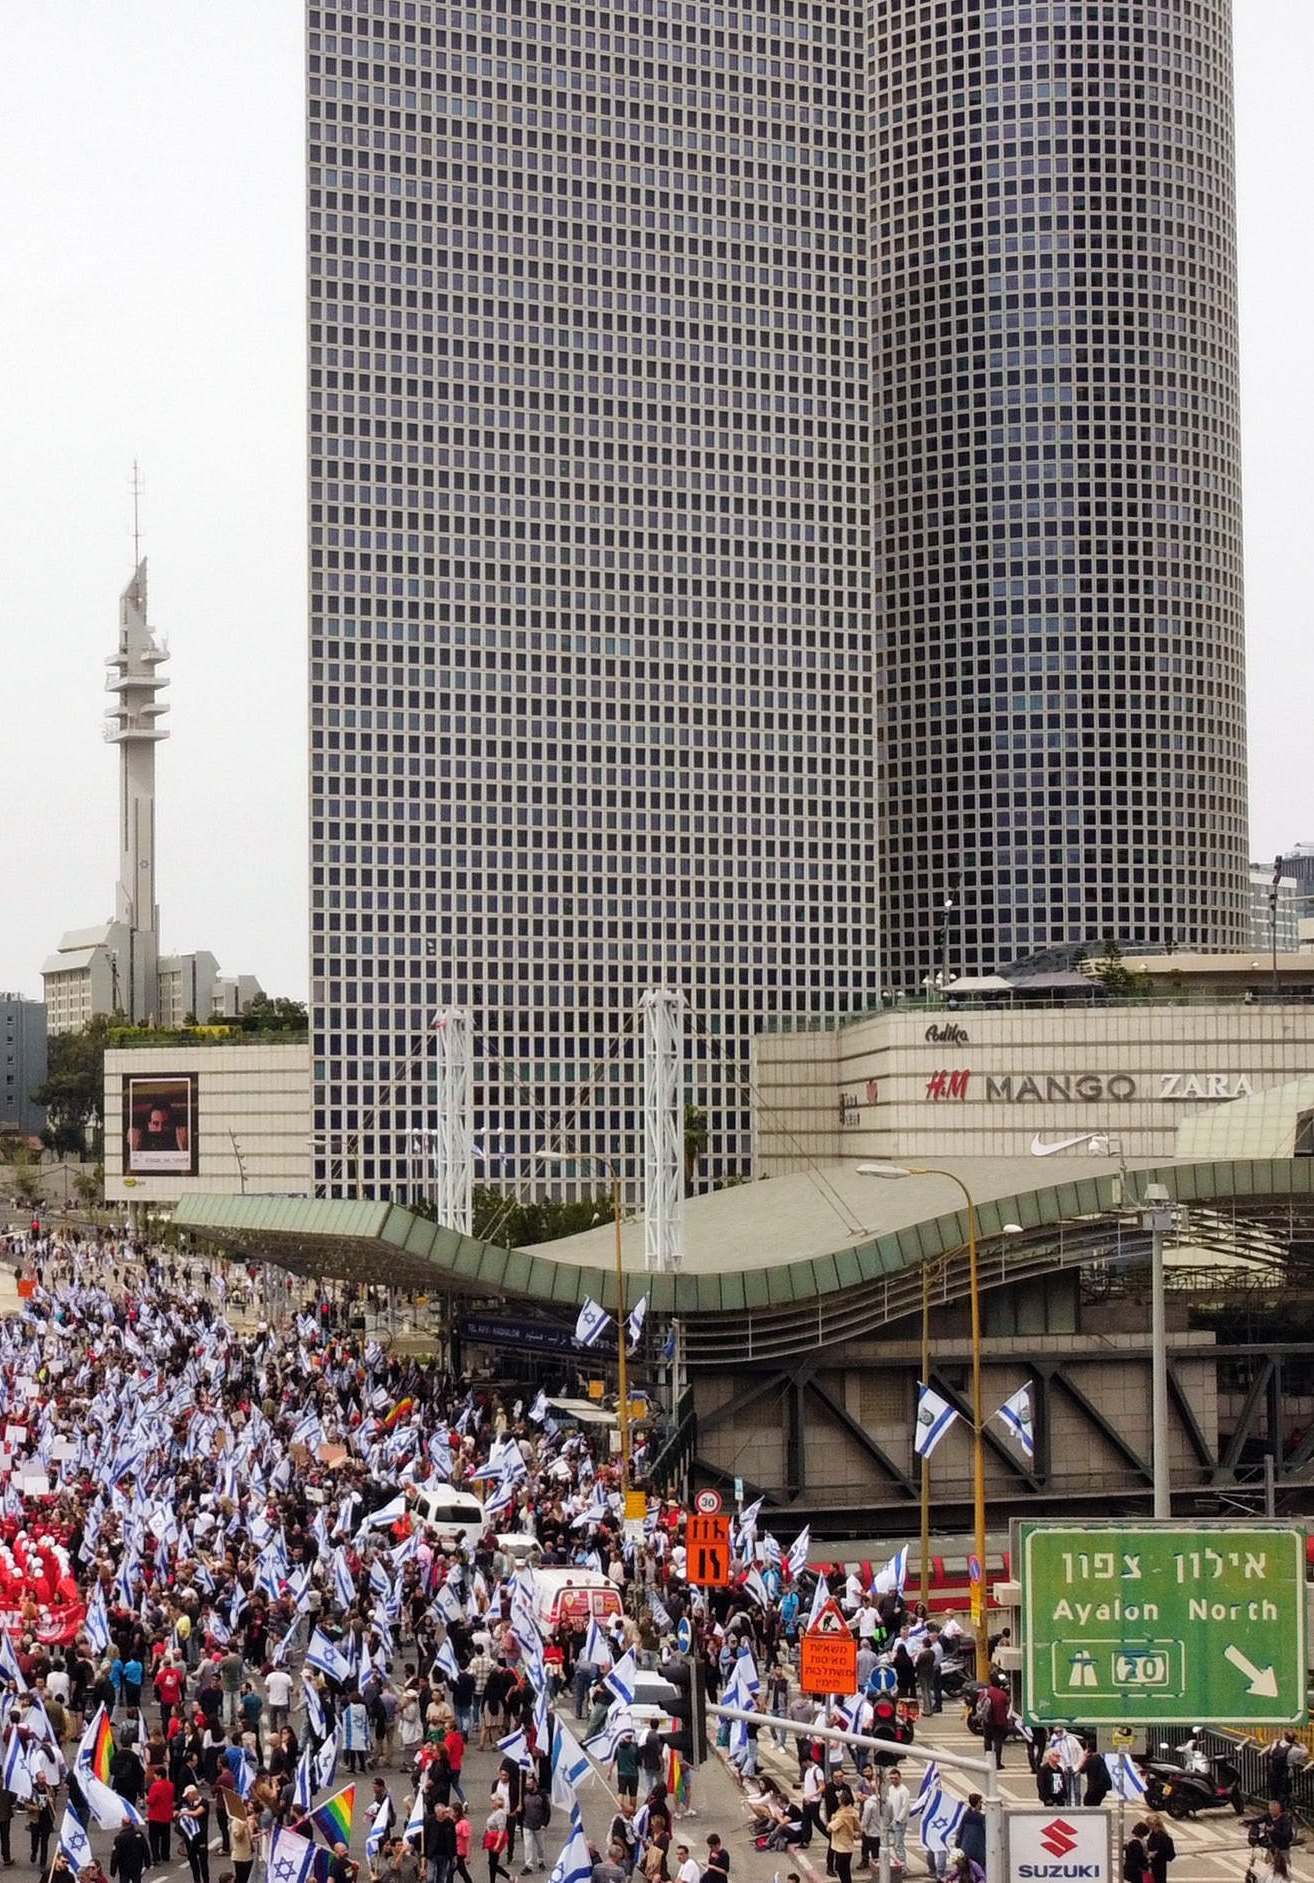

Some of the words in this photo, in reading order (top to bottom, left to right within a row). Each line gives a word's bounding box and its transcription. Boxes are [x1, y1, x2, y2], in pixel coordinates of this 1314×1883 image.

[925, 1023, 969, 1047] Adika
[926, 1069, 970, 1100] H&M
[986, 1074, 1135, 1102] MANGO
[1160, 1074, 1253, 1099] ZARA
[701, 1497, 715, 1507] 30
[1062, 1552, 1141, 1583] צפון
[1174, 1547, 1266, 1583] אילון
[1053, 1598, 1159, 1625] Ayalon
[1189, 1599, 1278, 1620] North
[810, 1644, 848, 1654] משאיות
[1124, 1659, 1157, 1679] 20
[1018, 1864, 1100, 1878] SUZUKI
